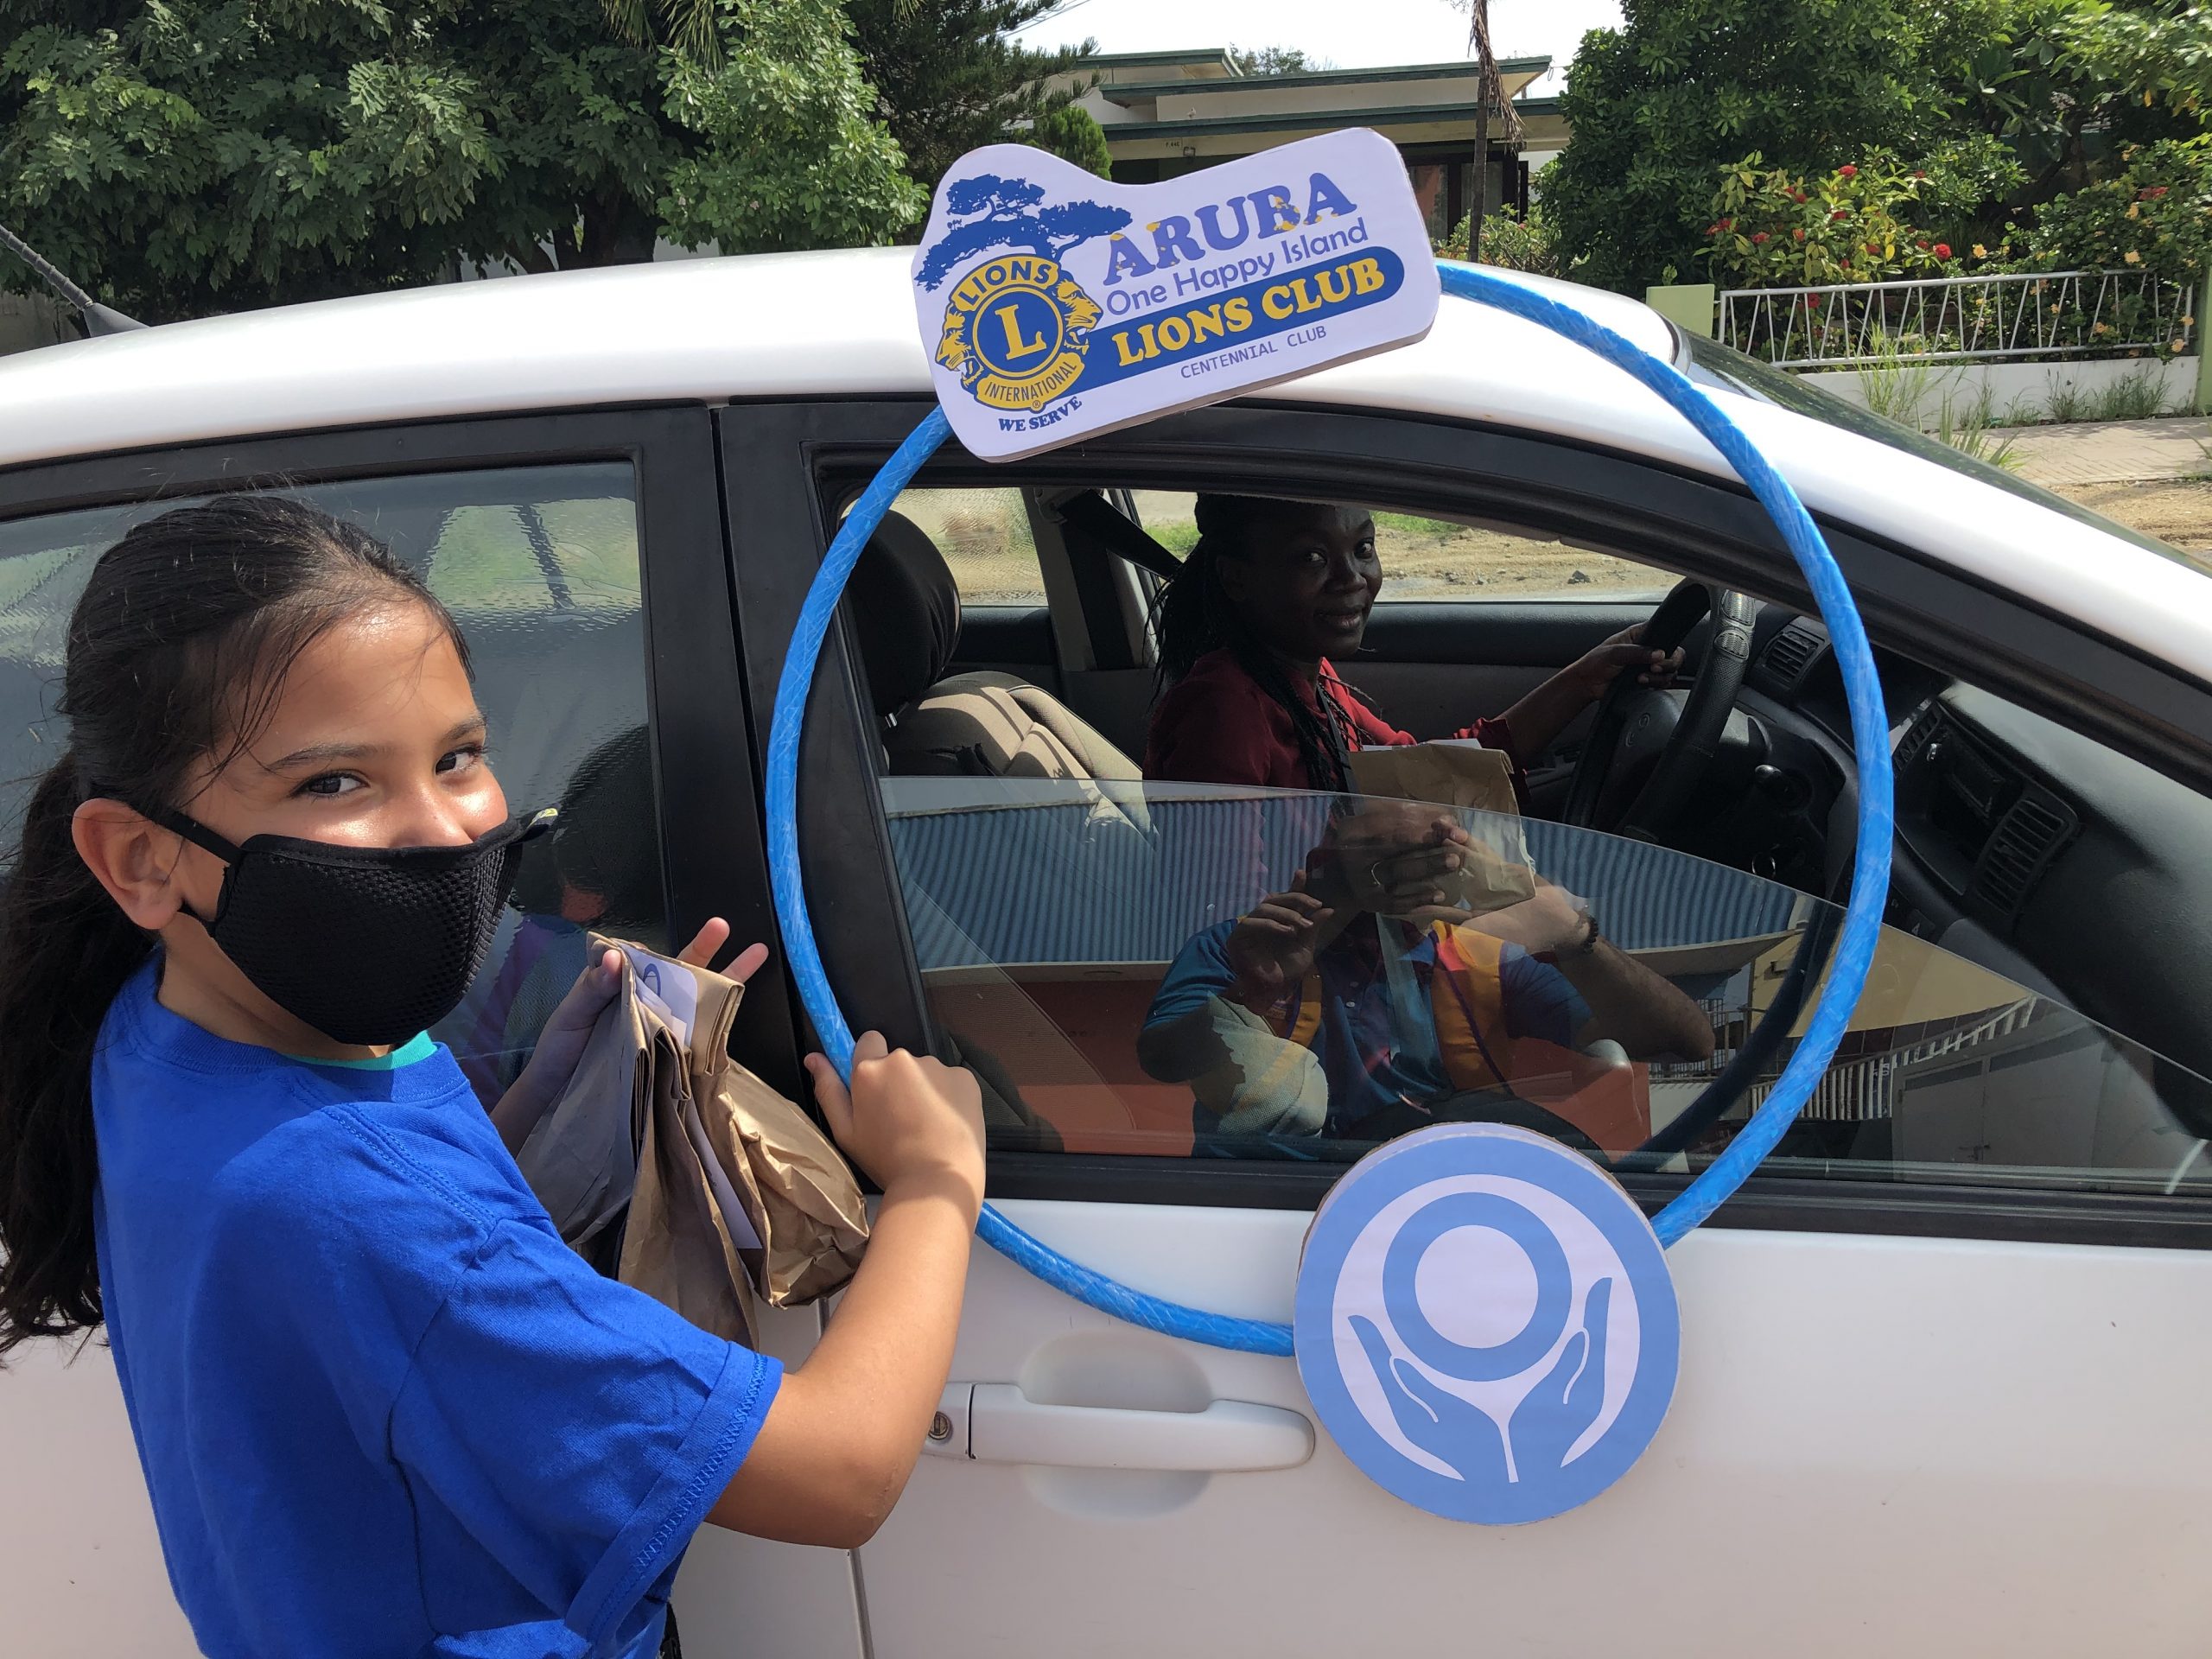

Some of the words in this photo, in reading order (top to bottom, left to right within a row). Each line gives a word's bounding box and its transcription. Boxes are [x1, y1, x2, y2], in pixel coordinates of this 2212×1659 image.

[1103, 173, 1357, 286] ARUBA
[957, 261, 1052, 307] LIONS
[1107, 284, 1167, 316] One
[1173, 251, 1274, 297] Happy
[1281, 217, 1368, 264] Island
[995, 304, 1046, 360] L
[1111, 296, 1253, 366] LIONS
[1262, 257, 1385, 320] CLUB
[1180, 340, 1278, 378] CENTENNIAL
[1287, 326, 1326, 347] CLUB
[984, 361, 1077, 402] INTERNATIONAL
[998, 417, 1027, 432] WE
[1029, 396, 1083, 429] SERVE
